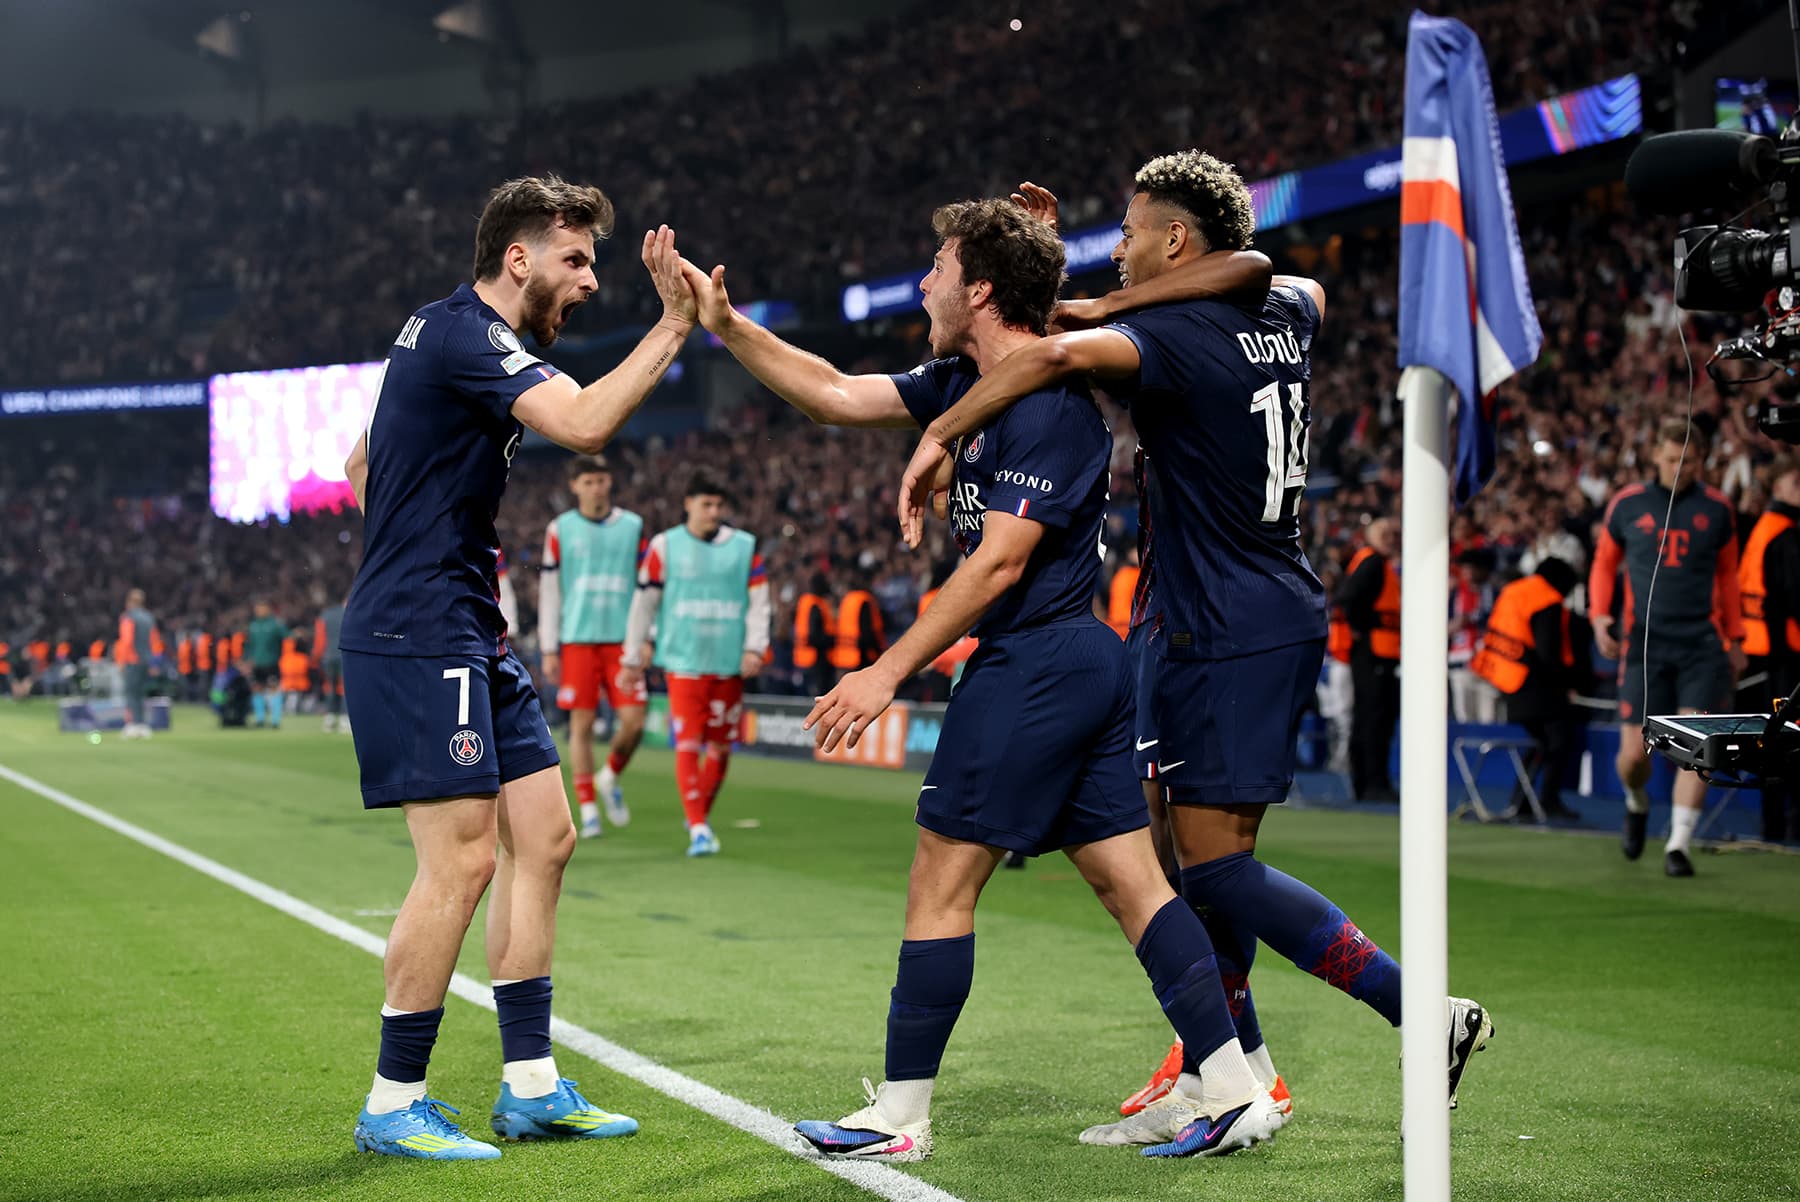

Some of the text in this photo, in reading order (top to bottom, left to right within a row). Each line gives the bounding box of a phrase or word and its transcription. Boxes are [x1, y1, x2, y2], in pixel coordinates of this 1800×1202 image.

[2, 382, 204, 413] UEFA CHAMPIONS LEAGUE
[1250, 380, 1310, 522] 14
[995, 470, 1053, 492] EYOND
[443, 667, 470, 725] 7
